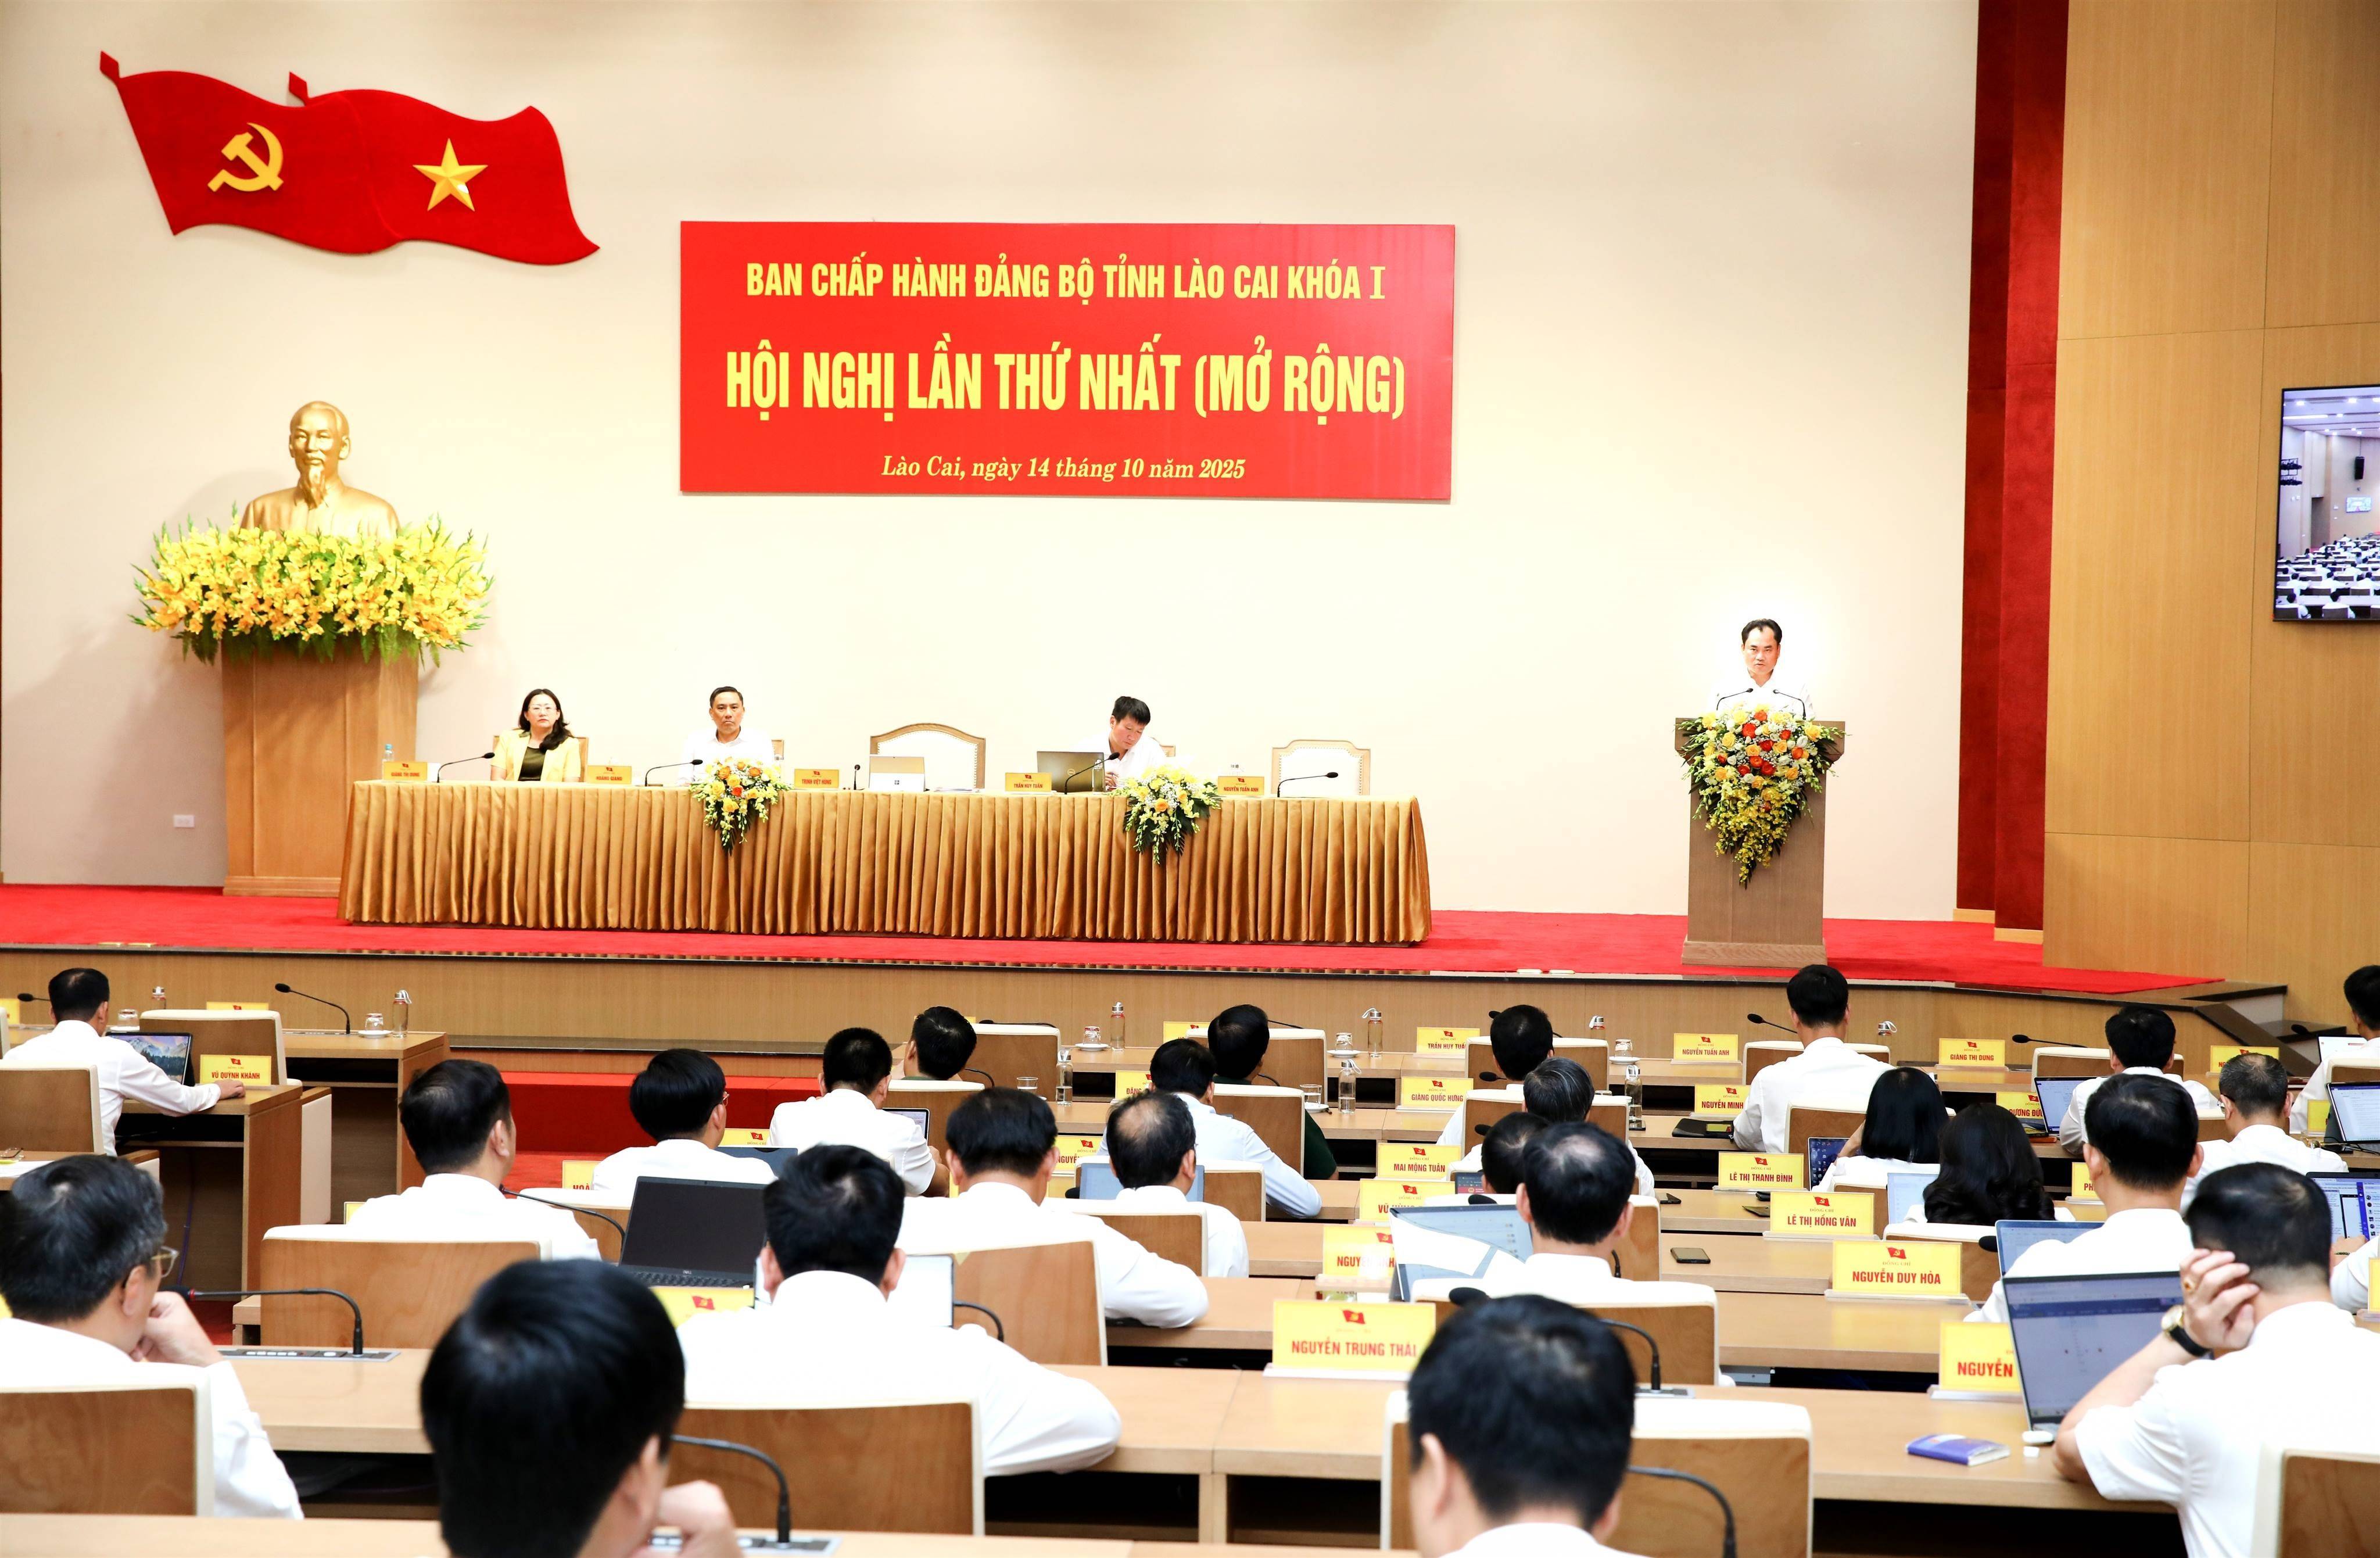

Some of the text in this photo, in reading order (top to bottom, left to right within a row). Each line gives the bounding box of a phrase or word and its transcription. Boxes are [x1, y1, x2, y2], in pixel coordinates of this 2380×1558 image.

[747, 252, 1386, 305] BAN CHẤP HÀNH ĐẢNG BỘ TỈNH LÀO CAI KHÓA I
[727, 333, 1404, 425] HỘI NGHỊ LẦN THỨ NHẤT (MỞ RỘNG)
[881, 456, 1246, 482] Lào Cai, ngày 14 tháng 10 năm 2025
[1701, 1099, 1726, 1109] NGUYỄN
[1730, 1172, 1793, 1183] LÊ THỊ THANH BÌNH
[1787, 1213, 1856, 1227] LÊ THỊ HỒNG VÂN
[1852, 1267, 1941, 1284] NGUYỄN DUY HÒA
[1292, 1336, 1340, 1355] NGUYỄN
[1345, 1341, 1385, 1356] TRUNG
[1958, 1357, 2013, 1377] NGUYỄN
